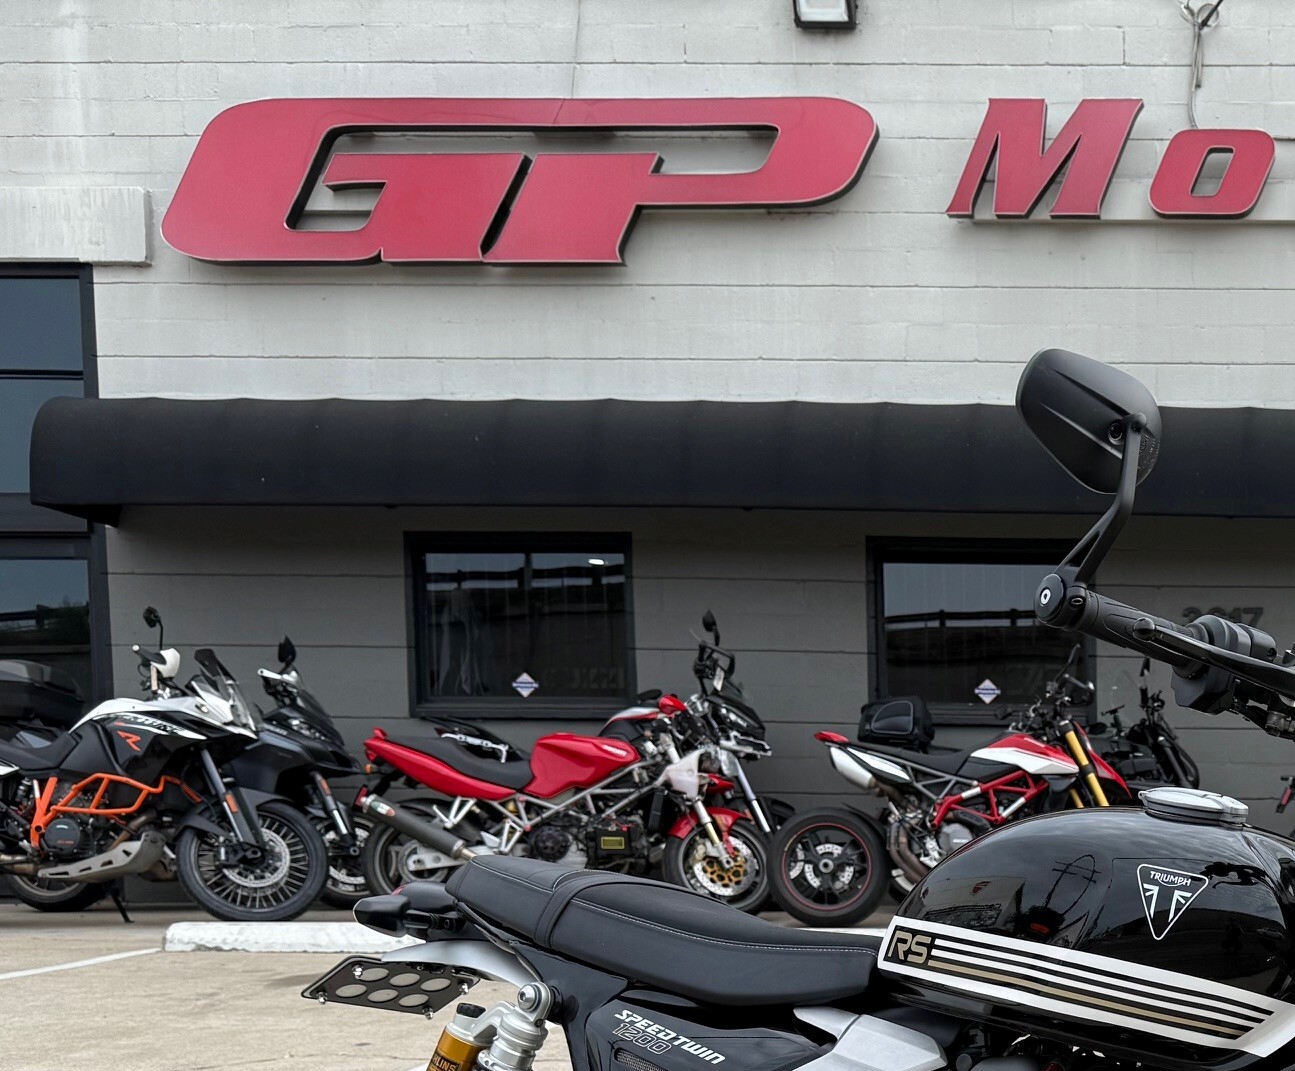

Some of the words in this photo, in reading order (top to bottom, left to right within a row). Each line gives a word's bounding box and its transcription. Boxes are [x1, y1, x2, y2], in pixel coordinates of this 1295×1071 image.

[161, 96, 879, 264] GP
[1150, 870, 1191, 887] TRIUMPH
[887, 930, 932, 964] RS
[612, 1022, 672, 1055] 1200
[614, 1009, 677, 1040] SPEED
[672, 1035, 726, 1065] TWIN
